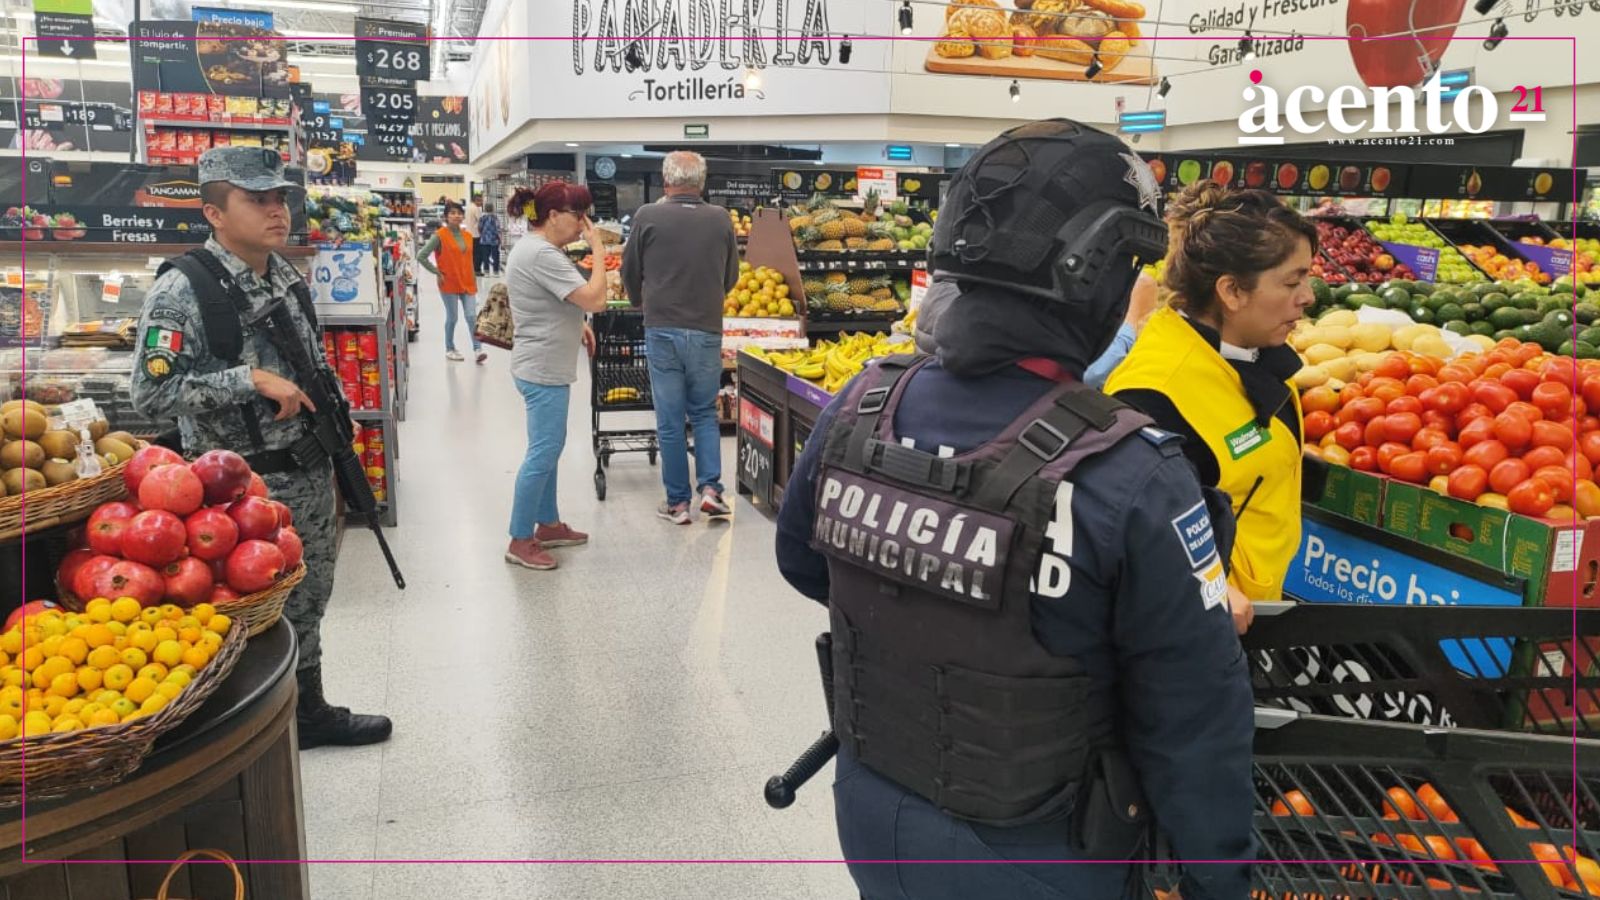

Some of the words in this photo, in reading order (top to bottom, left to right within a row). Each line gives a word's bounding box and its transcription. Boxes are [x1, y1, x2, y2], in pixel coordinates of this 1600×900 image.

[211, 14, 242, 26] Precio
[244, 17, 265, 28] bajo
[1189, 3, 1245, 34] Calidad
[1249, 6, 1258, 29] y
[378, 27, 416, 38] Premium
[1209, 29, 1304, 65] Garatizada
[644, 77, 745, 100] Tortillería
[149, 187, 201, 196] TANGAMAN
[102, 213, 153, 228] Berries
[156, 219, 164, 229] y
[112, 229, 157, 242] Fresas
[819, 478, 998, 567] POLICÍA
[815, 514, 991, 600] MUNICIPAL
[1304, 534, 1397, 601] Precio
[1303, 568, 1335, 593] Todos
[1337, 583, 1354, 602] los
